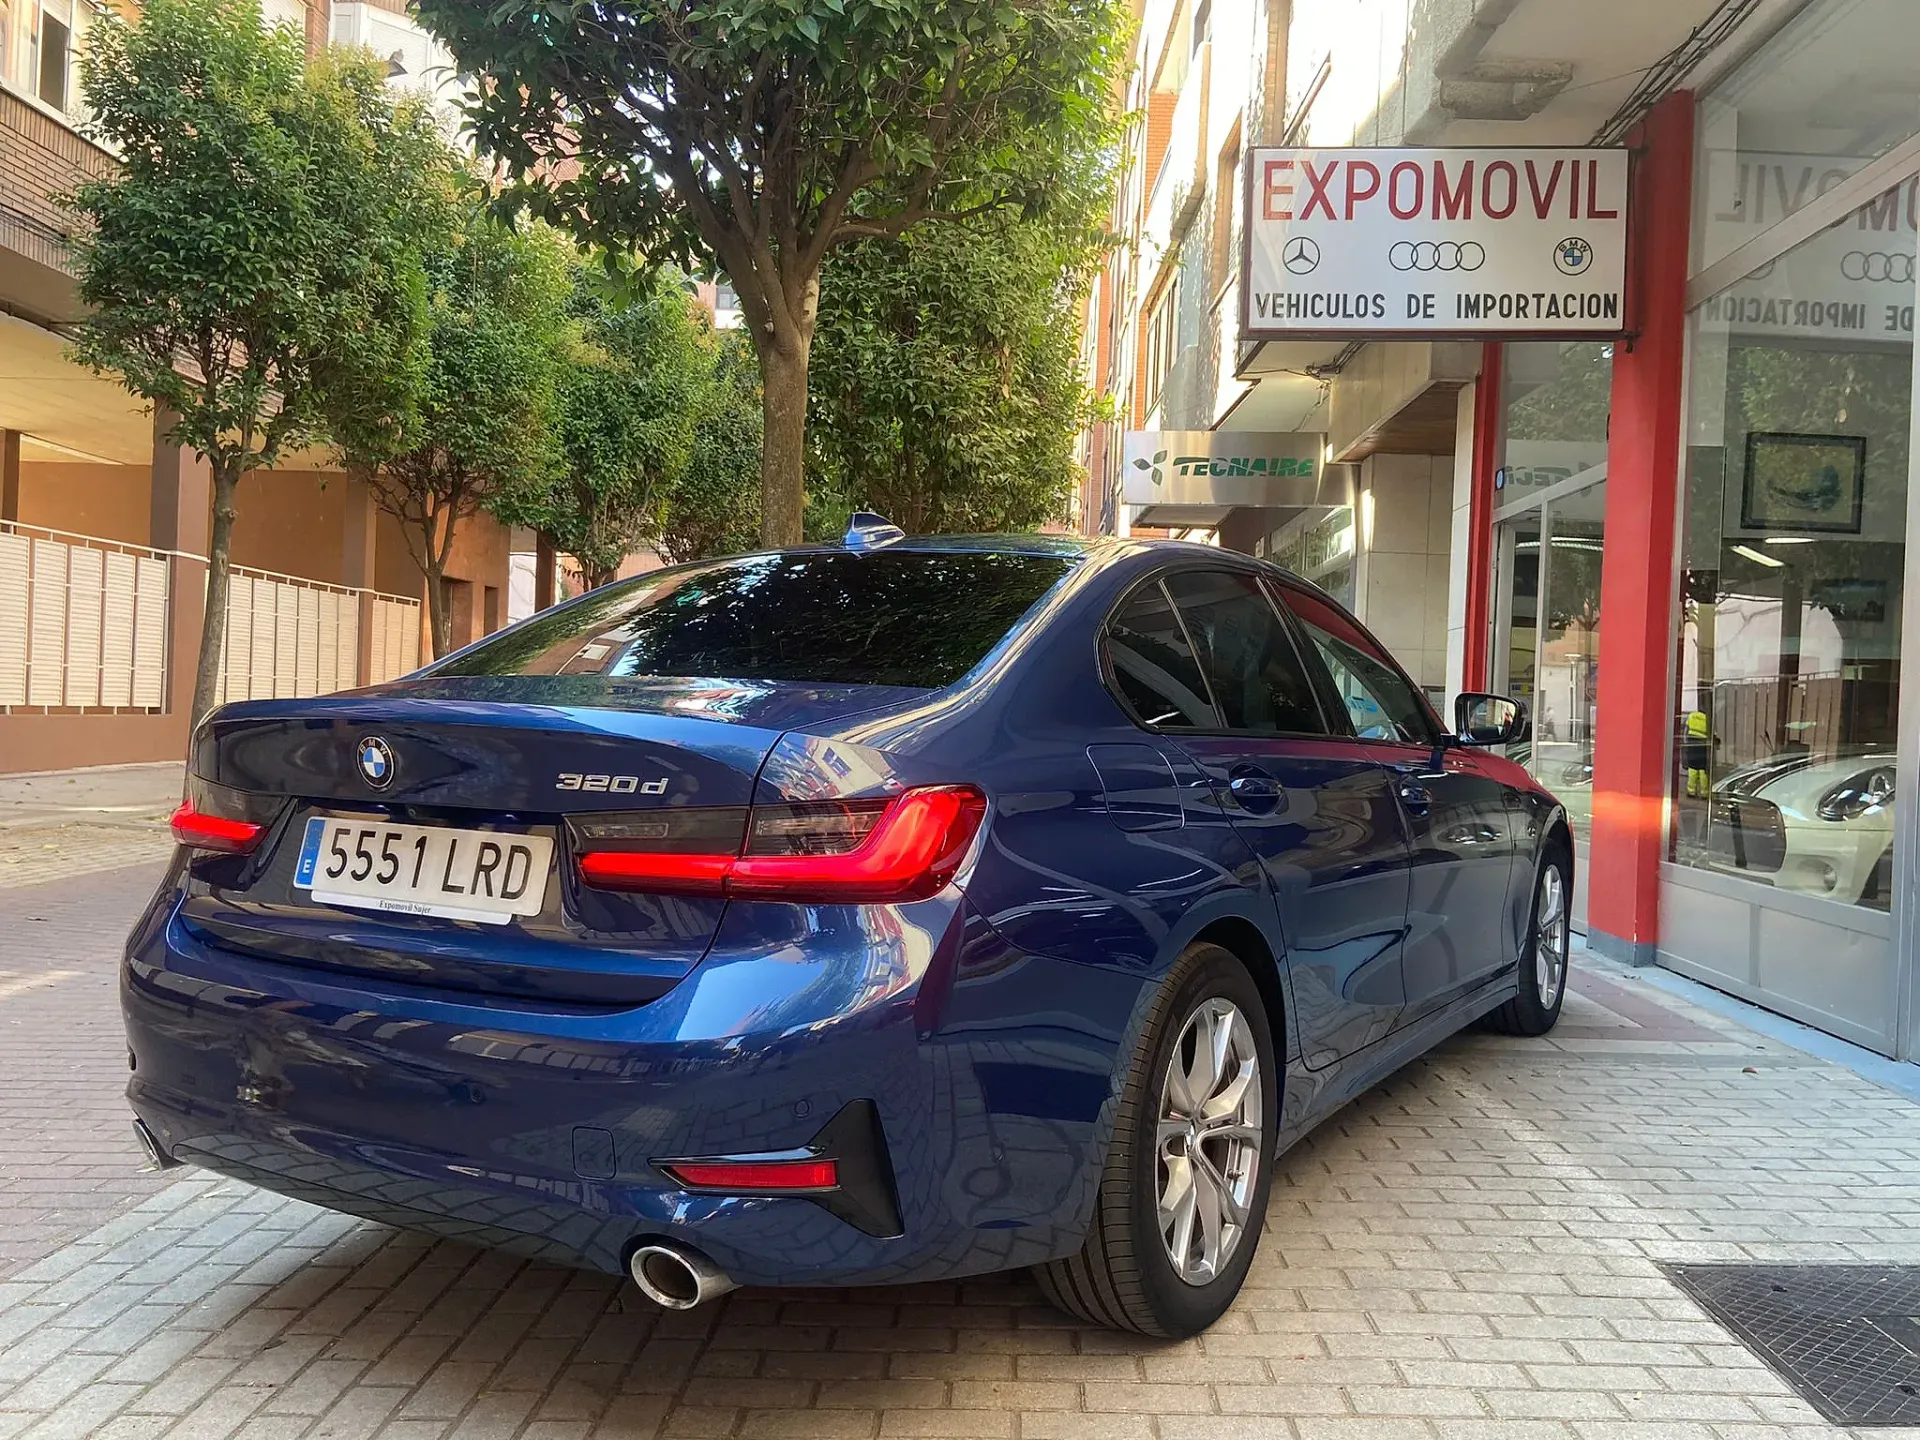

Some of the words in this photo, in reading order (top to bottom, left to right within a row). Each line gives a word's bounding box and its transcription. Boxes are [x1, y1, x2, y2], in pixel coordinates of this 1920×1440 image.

[1263, 160, 1618, 221] EXPOMOVIL
[1559, 240, 1589, 253] BMW
[1255, 293, 1386, 319] VEHICULOS
[1407, 293, 1435, 319] DE
[1456, 293, 1618, 319] IMPORTACION
[1173, 456, 1315, 477] TECNAIRE
[359, 739, 388, 755] BMW
[556, 773, 669, 795] 320d
[302, 859, 312, 874] E
[326, 828, 428, 888] 5551
[441, 838, 533, 900] LRD
